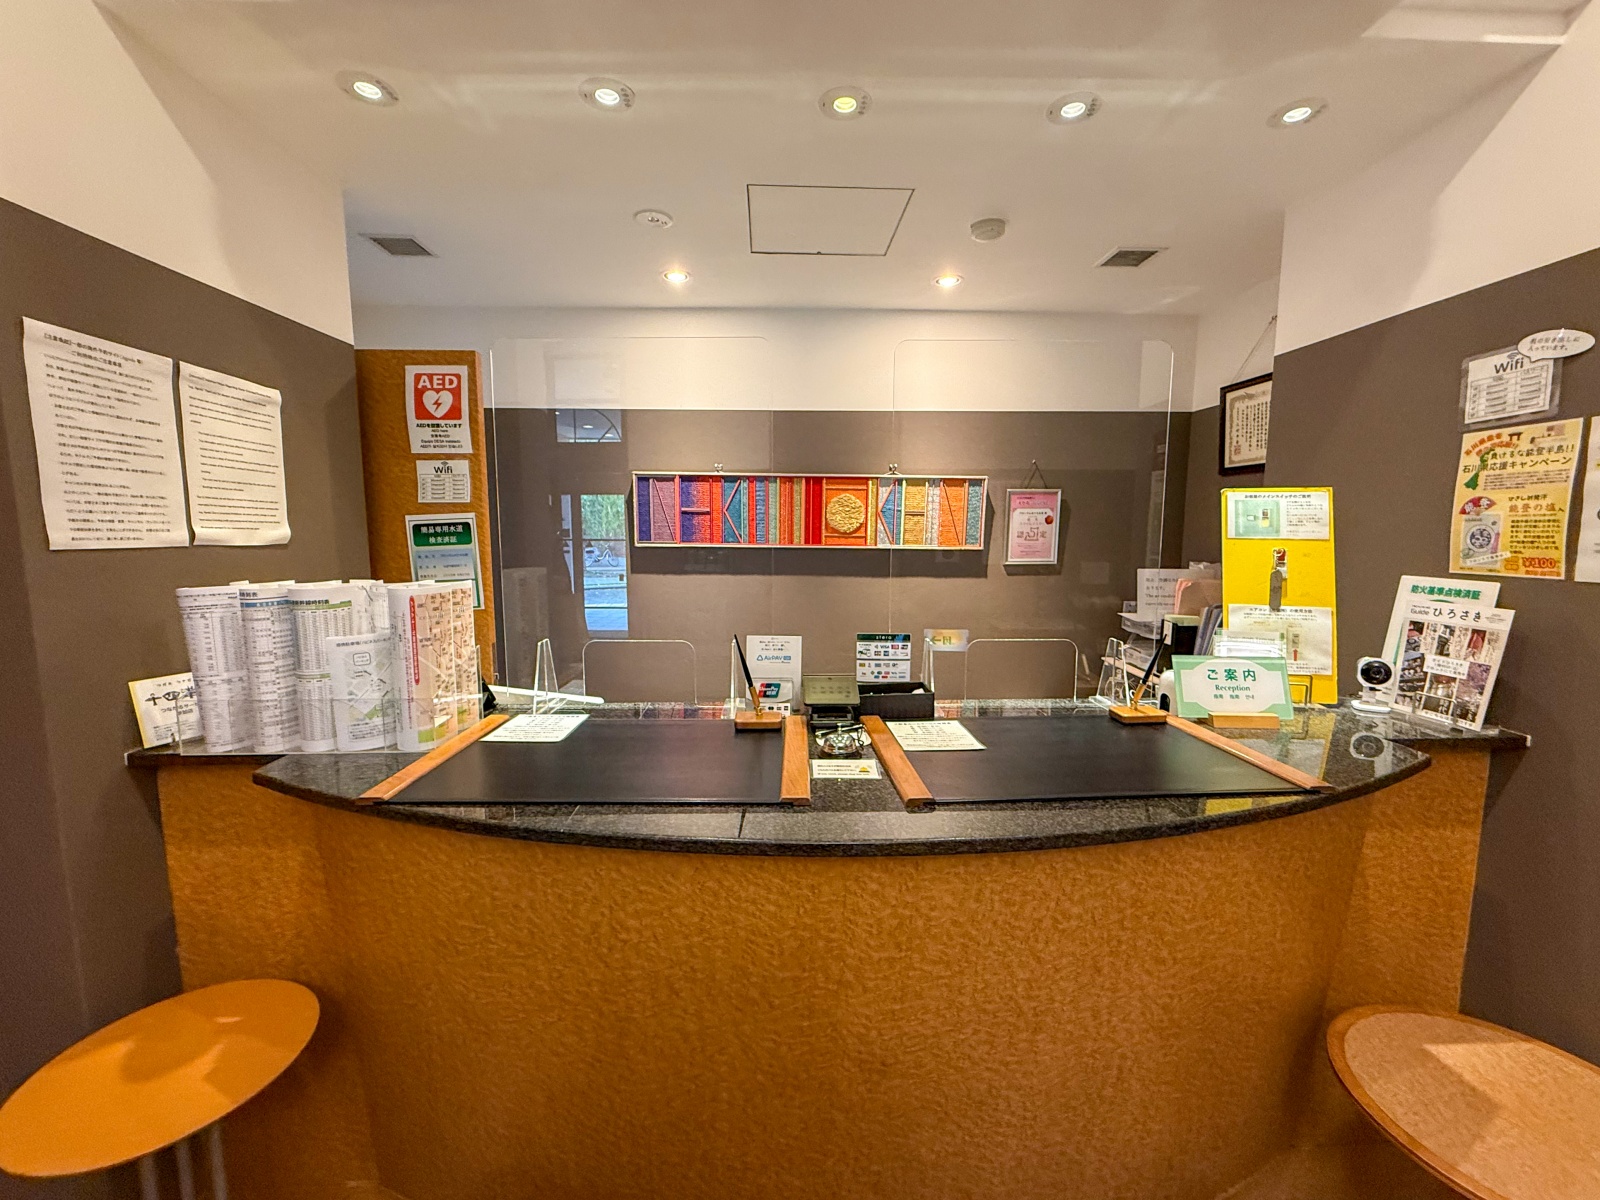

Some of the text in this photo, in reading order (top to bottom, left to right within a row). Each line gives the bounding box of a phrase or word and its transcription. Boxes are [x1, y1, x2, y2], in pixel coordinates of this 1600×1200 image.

[1494, 357, 1524, 374] Wifi
[417, 375, 458, 389] AED
[433, 466, 453, 474] Wifi
[1462, 456, 1572, 474] 石川県応援キャンペーン
[1410, 584, 1482, 600] 防火基準点検済証
[1410, 608, 1430, 616] Guide
[1432, 607, 1482, 623] ひろさき
[1207, 668, 1257, 682] ご案内
[1215, 684, 1251, 692] Reception
